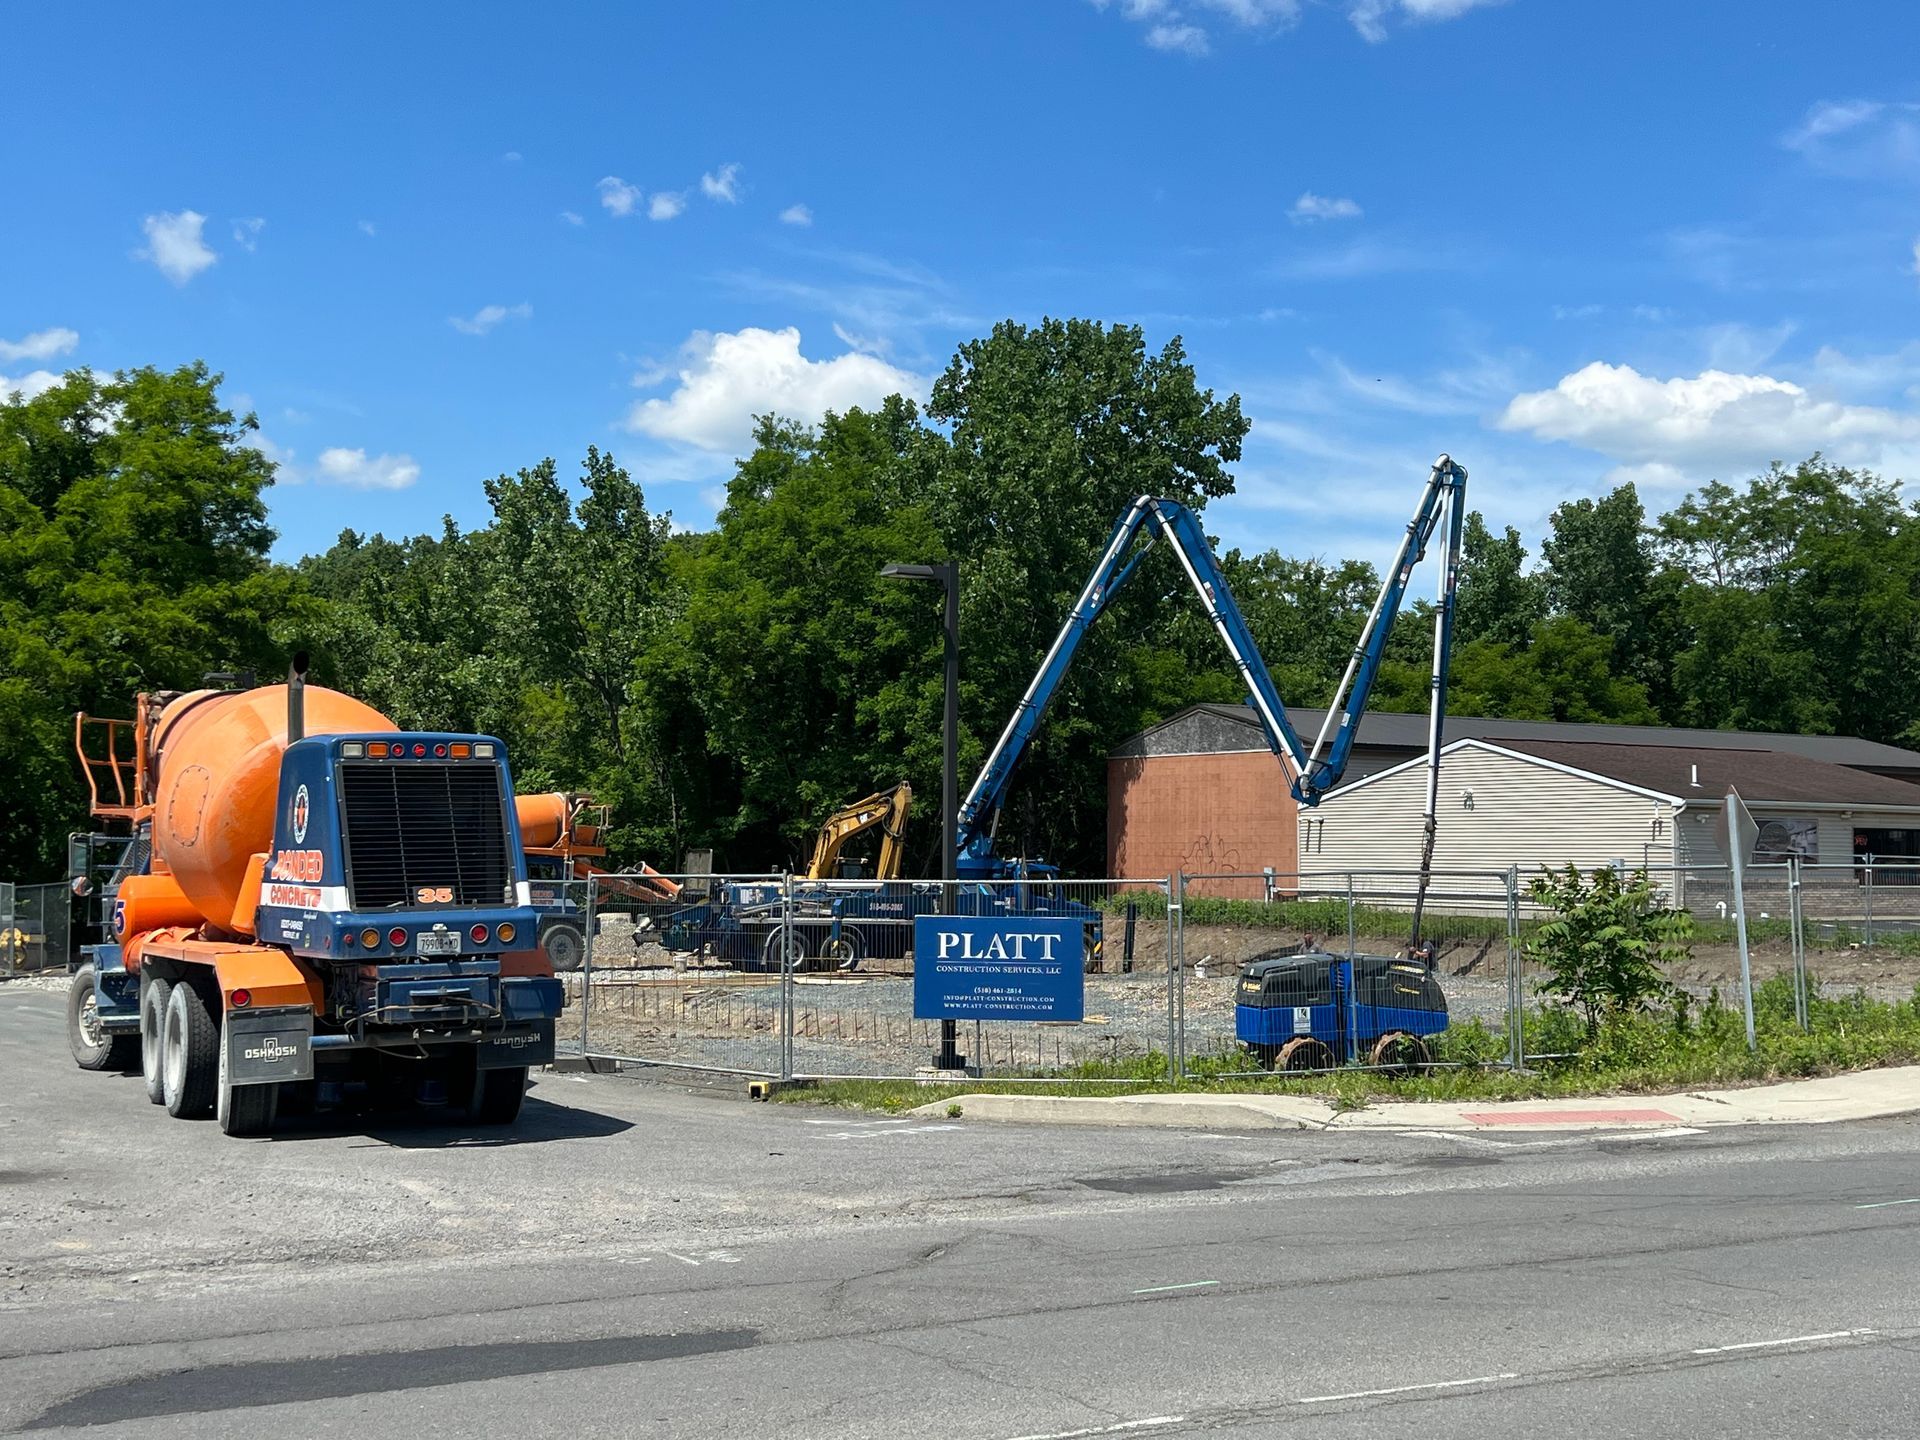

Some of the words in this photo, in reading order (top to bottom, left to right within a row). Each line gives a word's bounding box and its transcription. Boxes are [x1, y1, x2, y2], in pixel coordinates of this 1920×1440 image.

[271, 850, 324, 883] BONDED
[417, 887, 454, 904] 35
[937, 932, 1061, 960] PLATT
[936, 965, 1001, 973] CONSTRUCTION
[1002, 966, 1044, 974] SERVICES,
[943, 1002, 1053, 1010] WWW.PLATT-CONSTRUCTION.COM
[244, 1045, 297, 1059] OSHKOSH
